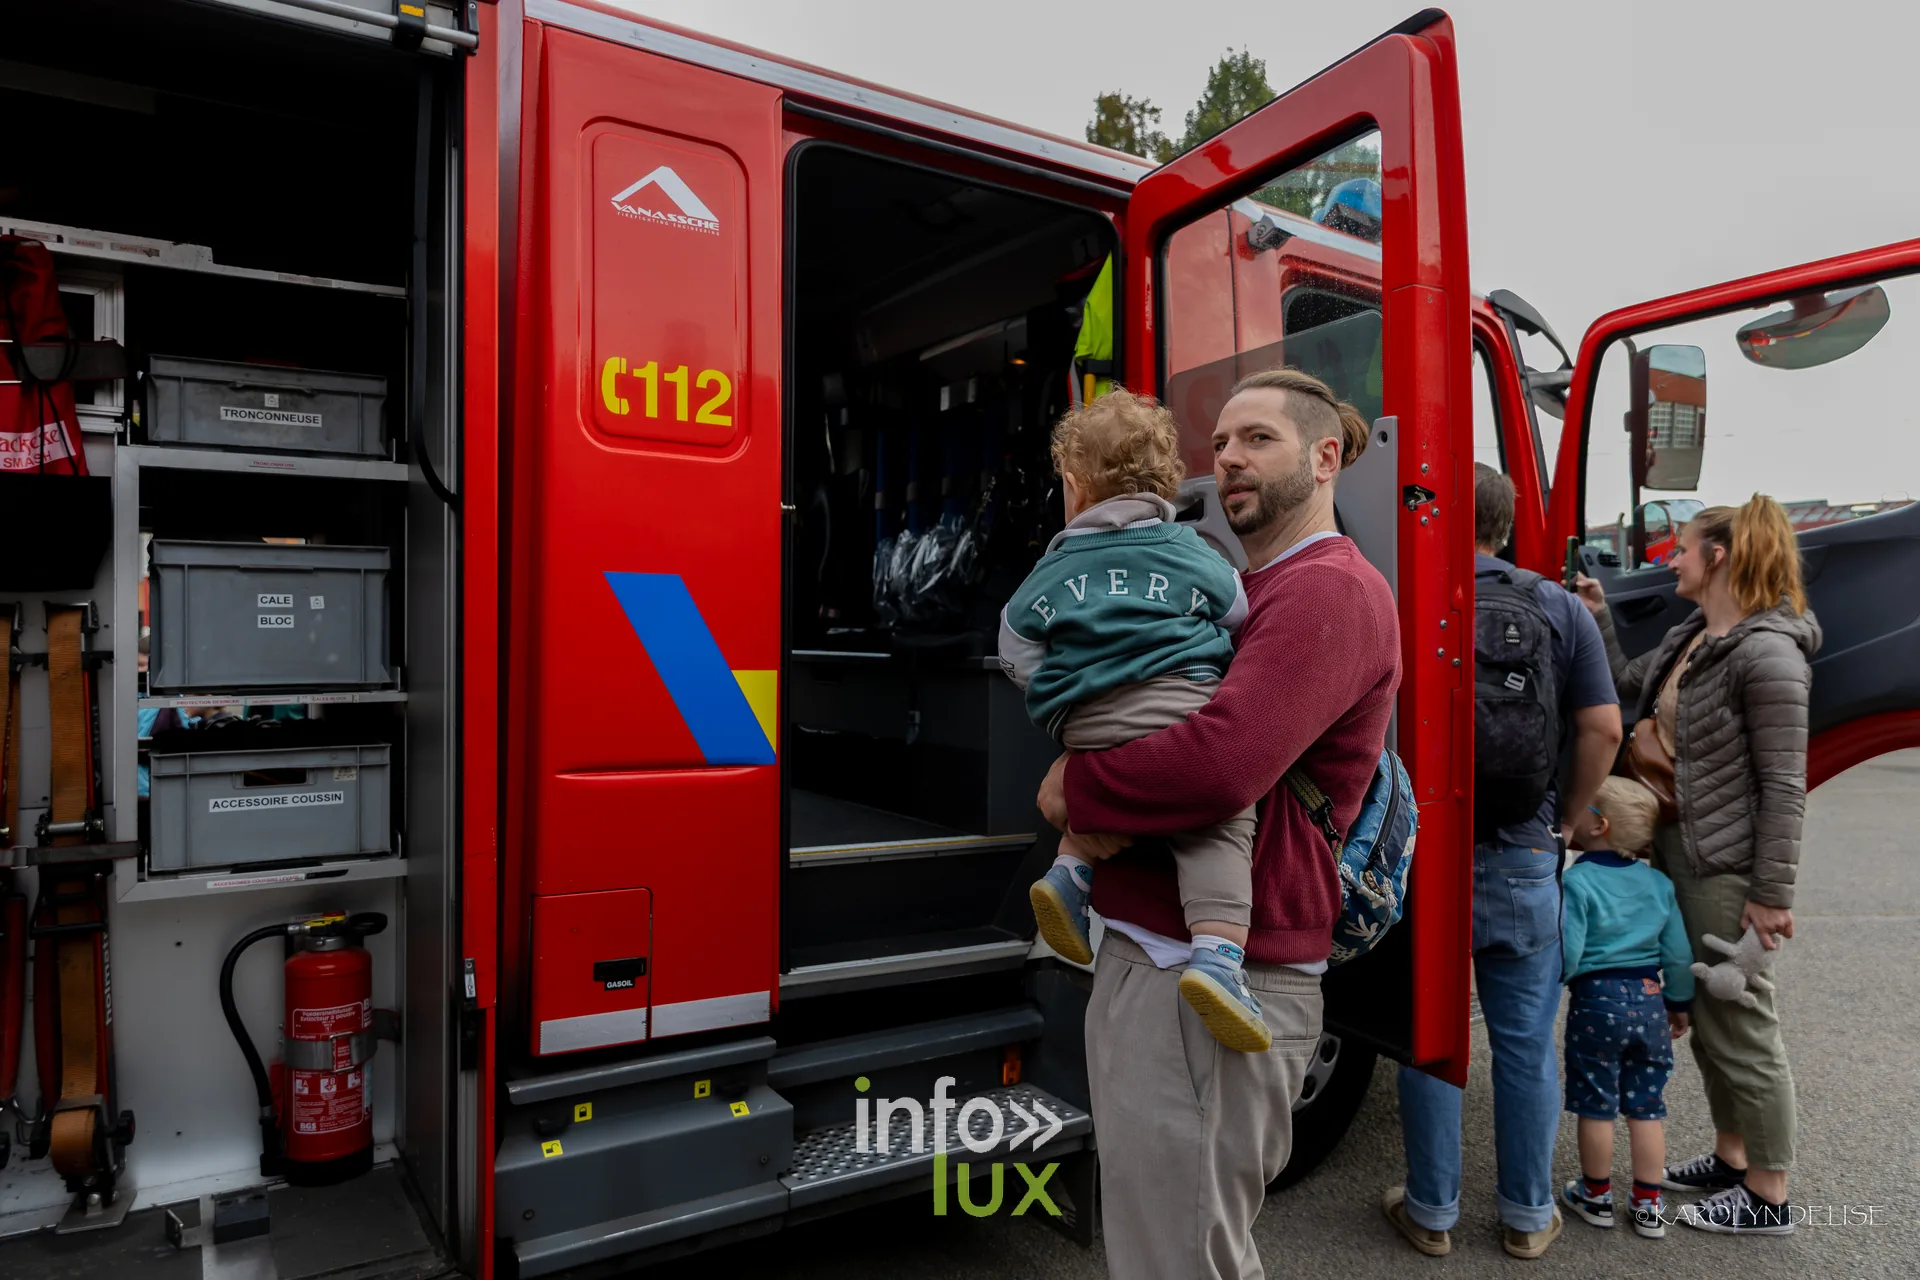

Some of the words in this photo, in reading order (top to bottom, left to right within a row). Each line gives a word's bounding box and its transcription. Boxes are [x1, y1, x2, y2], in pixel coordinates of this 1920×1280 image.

[610, 201, 720, 231] VANASSCHE
[616, 211, 669, 226] FIREFIGHTING
[673, 222, 720, 236] ENGINEERING
[633, 361, 733, 427] 112
[222, 408, 321, 424] TRONCONNEUSE
[3, 450, 52, 468] SMASH
[260, 596, 292, 605] CALE
[1030, 568, 1208, 627] EVERY
[260, 616, 292, 626] BLOC
[212, 796, 289, 810] ACCESSOIRE
[291, 792, 343, 805] COUSSIN
[606, 979, 634, 989] GASOIL
